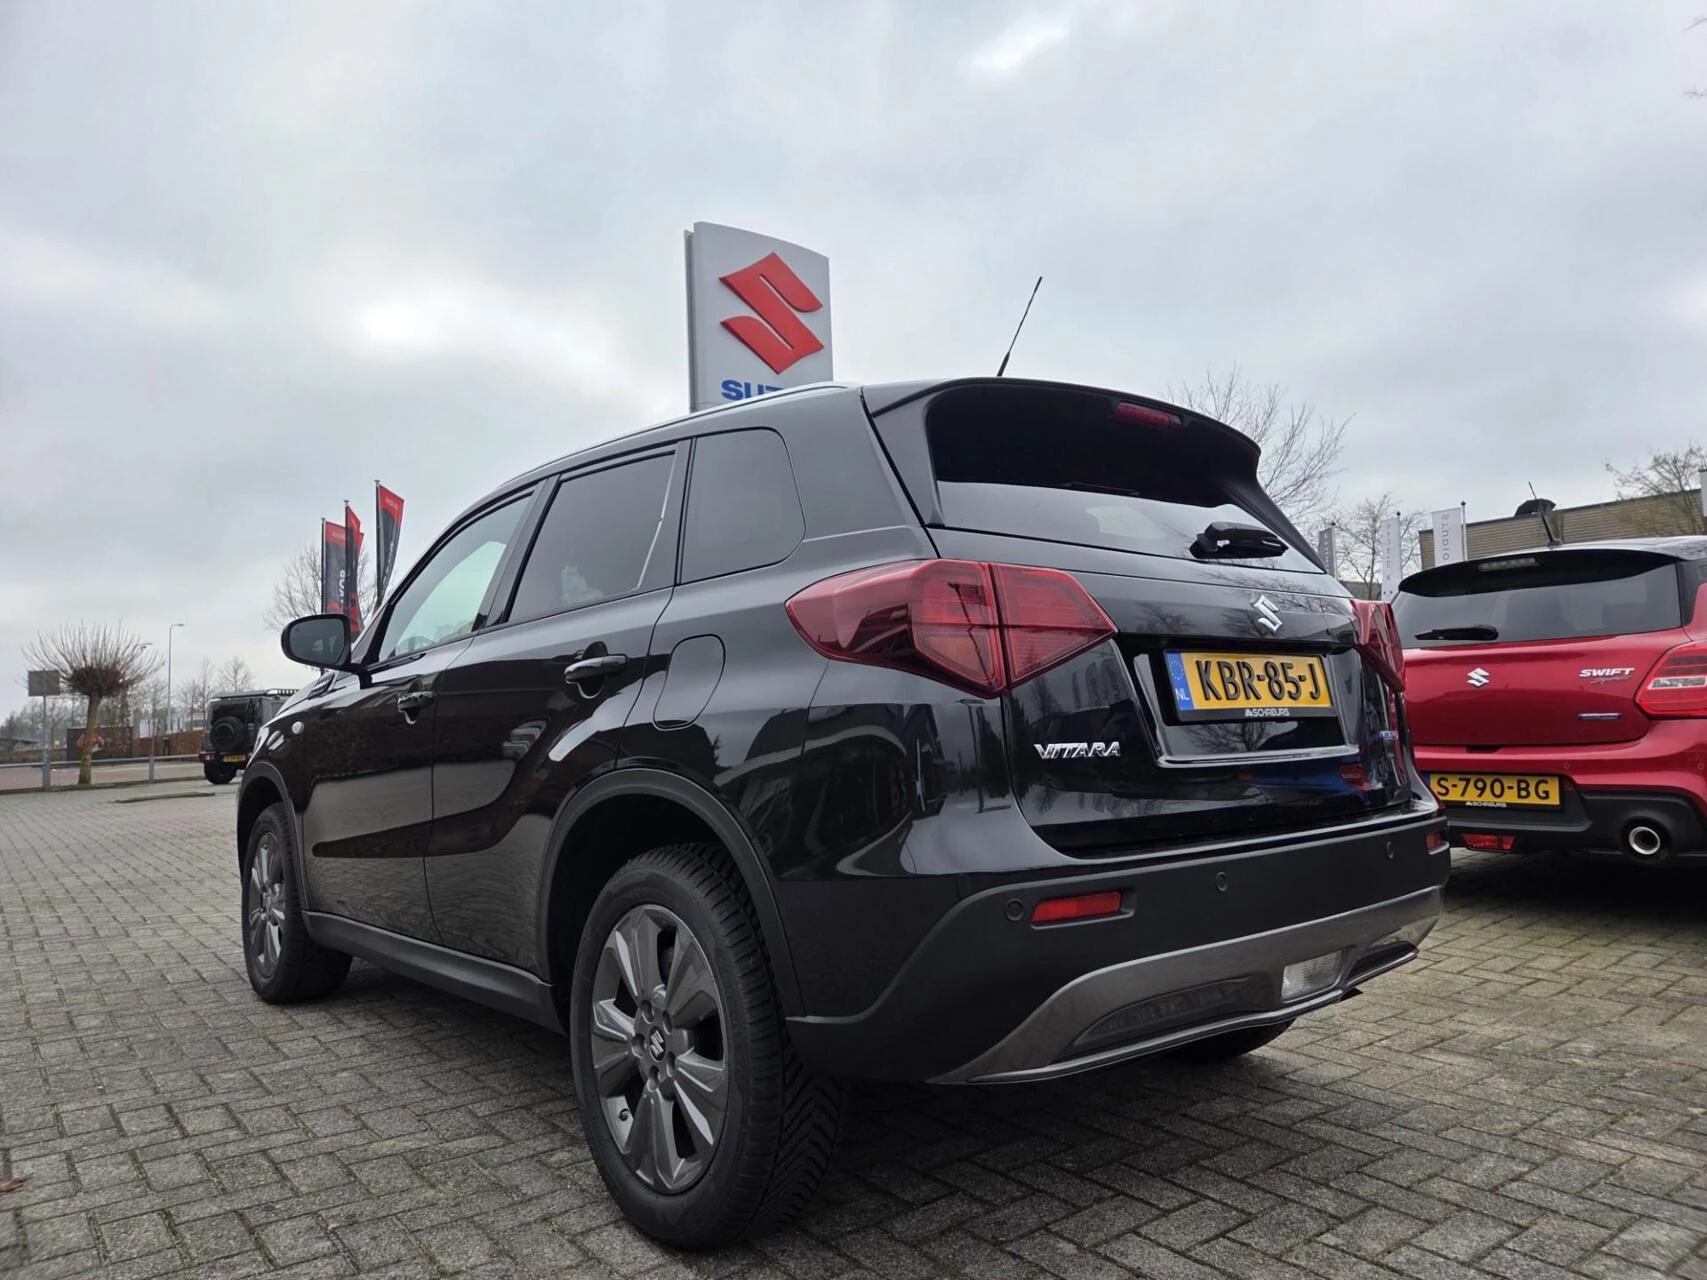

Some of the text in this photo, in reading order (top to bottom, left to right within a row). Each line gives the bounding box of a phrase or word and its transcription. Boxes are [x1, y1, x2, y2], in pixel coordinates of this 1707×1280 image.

[721, 379, 783, 401] SU
[1195, 660, 1321, 701] KBR-85-J
[1578, 667, 1635, 678] SWIFT
[1175, 687, 1190, 701] NL
[1033, 741, 1121, 760] VITARA
[1436, 776, 1550, 800] S-790-BG
